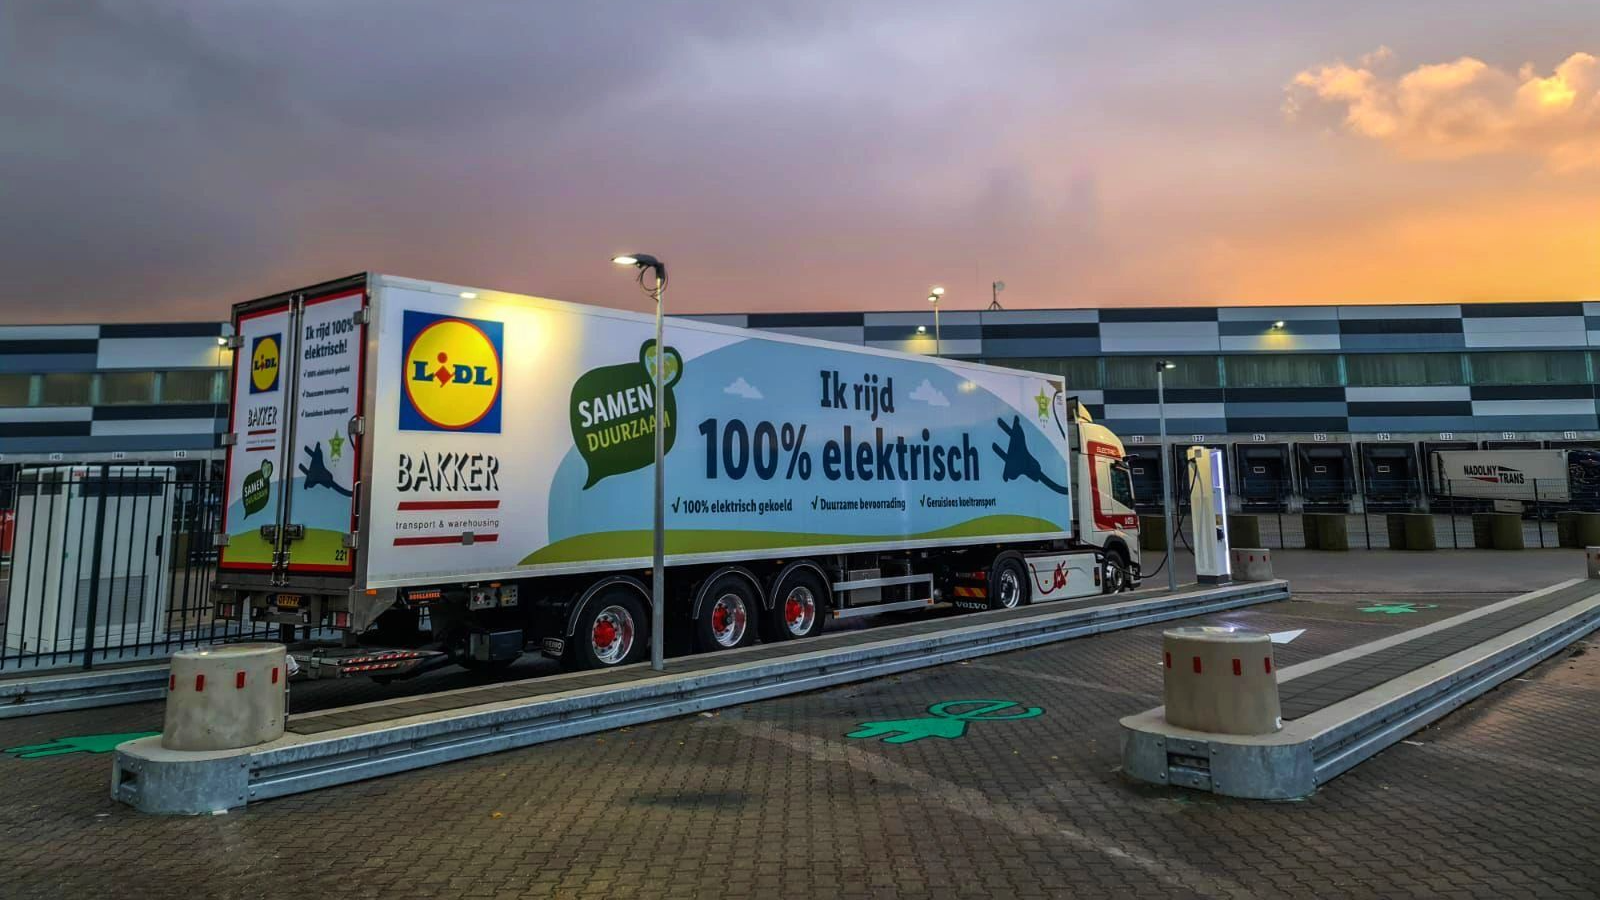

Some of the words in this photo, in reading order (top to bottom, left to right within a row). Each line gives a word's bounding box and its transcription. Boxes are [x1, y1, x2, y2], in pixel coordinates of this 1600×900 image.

[305, 325, 314, 340] Ik
[316, 321, 330, 340] rijd
[332, 318, 354, 335] 100%
[304, 338, 348, 360] elektrisch!
[820, 370, 846, 408] Ik
[853, 372, 895, 422] rijd
[578, 383, 654, 428] SAMEN
[698, 417, 812, 482] 100%
[822, 425, 980, 482] elektrisch
[396, 451, 500, 492] BAKKER
[1463, 464, 1497, 476] NADOLNY
[1498, 472, 1525, 485] TRANS
[683, 500, 709, 514] 100%
[711, 498, 756, 513] elektrisch
[758, 498, 792, 515] gekoeld
[820, 498, 858, 511] Duurzame
[860, 497, 906, 512] bevoorrading
[960, 496, 996, 508] koeltransport
[396, 520, 436, 530] transport
[438, 520, 444, 528] &
[448, 518, 500, 528] warehousing
[956, 600, 988, 610] VOLVO
